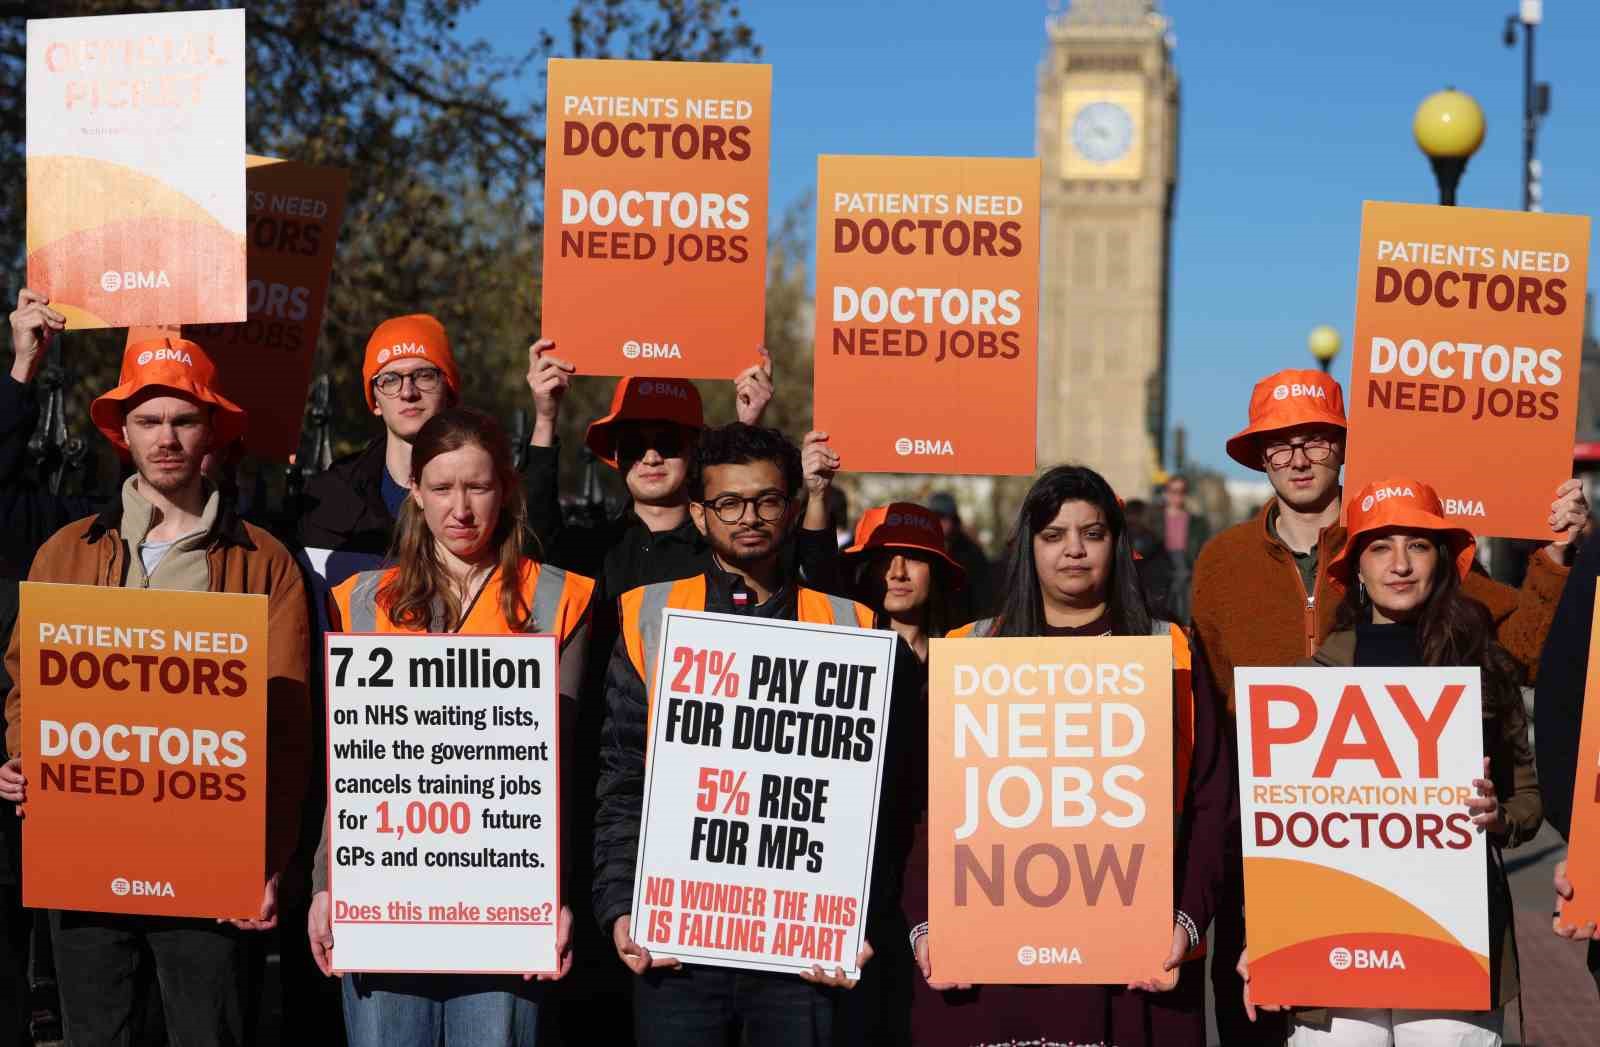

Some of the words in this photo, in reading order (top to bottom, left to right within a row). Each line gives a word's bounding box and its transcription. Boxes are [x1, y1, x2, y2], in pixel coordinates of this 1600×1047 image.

[564, 96, 678, 119] PATIENTS
[685, 98, 752, 121] NEED
[563, 121, 751, 161] DOCTORS
[271, 195, 328, 218] NEED
[561, 189, 750, 229] DOCTORS
[834, 193, 949, 215] PATIENTS
[956, 195, 1023, 216] NEED
[560, 230, 656, 260] NEED
[663, 233, 748, 266] JOBS
[833, 218, 1022, 257] DOCTORS
[1377, 240, 1495, 267] PATIENTS
[1502, 248, 1570, 273] NEED
[124, 271, 170, 290] BMA
[1375, 266, 1567, 315] DOCTORS
[832, 287, 1021, 326] DOCTORS
[155, 351, 193, 366] BMA
[392, 342, 426, 356] BMA
[642, 343, 681, 359] BMA
[832, 328, 927, 357] NEED
[935, 330, 1020, 363] JOBS
[1370, 336, 1563, 386] DOCTORS
[655, 382, 688, 399] BMA
[1291, 384, 1326, 399] BMA
[1367, 379, 1466, 414] NEED
[1472, 388, 1560, 421] JOBS
[914, 440, 954, 456] BMA
[1375, 486, 1414, 502] BMA
[1446, 498, 1486, 517] BMA
[904, 514, 934, 531] BMA
[39, 623, 166, 649] PATIENTS
[173, 631, 248, 655] NEED
[39, 649, 247, 698] DOCTORS
[330, 647, 393, 688] 7.2
[409, 648, 541, 688] million
[672, 646, 741, 698] 21%
[748, 655, 809, 703] PAY
[814, 662, 877, 710] CUT
[953, 663, 1145, 697] DOCTORS
[333, 708, 358, 726] on
[365, 705, 408, 727] NHS
[414, 706, 486, 731] waiting
[492, 705, 540, 731] lists,
[665, 698, 726, 747] FOR
[731, 704, 876, 763] DOCTORS
[953, 703, 1146, 758] NEED
[1248, 684, 1467, 778] PAY
[39, 720, 247, 768] DOCTORS
[334, 739, 386, 761] while
[392, 739, 424, 761] the
[430, 741, 548, 765] government
[40, 765, 145, 797] NEED
[153, 770, 247, 802] JOBS
[335, 774, 412, 796] cancels
[417, 774, 494, 799] training
[498, 775, 541, 799] jobs
[696, 766, 751, 816] 5%
[757, 773, 830, 824] RISE
[1252, 784, 1419, 806] RESTORATION
[1424, 785, 1471, 806] FOR
[954, 766, 1146, 840] JOBS
[338, 809, 367, 831] for
[376, 801, 470, 841] 1,000
[482, 808, 542, 830] future
[1254, 811, 1473, 850] DOCTORS
[336, 846, 375, 868] GPs
[381, 846, 418, 868] and
[424, 847, 545, 869] consultants.
[689, 817, 749, 866] FOR
[756, 823, 824, 875] MPs
[132, 880, 175, 898] BMA
[954, 843, 1145, 908] NOW
[335, 901, 381, 922] Does
[386, 902, 423, 922] this
[428, 902, 480, 922] make
[486, 902, 554, 923] sense?
[645, 876, 675, 909] NO
[680, 880, 767, 917] WONDER
[773, 888, 809, 921] THE
[813, 894, 857, 928] NHS
[647, 910, 672, 944] IS
[677, 914, 767, 954] FALLING
[772, 923, 847, 962] APART
[1039, 948, 1082, 964] BMA
[1355, 949, 1406, 970] BMA
